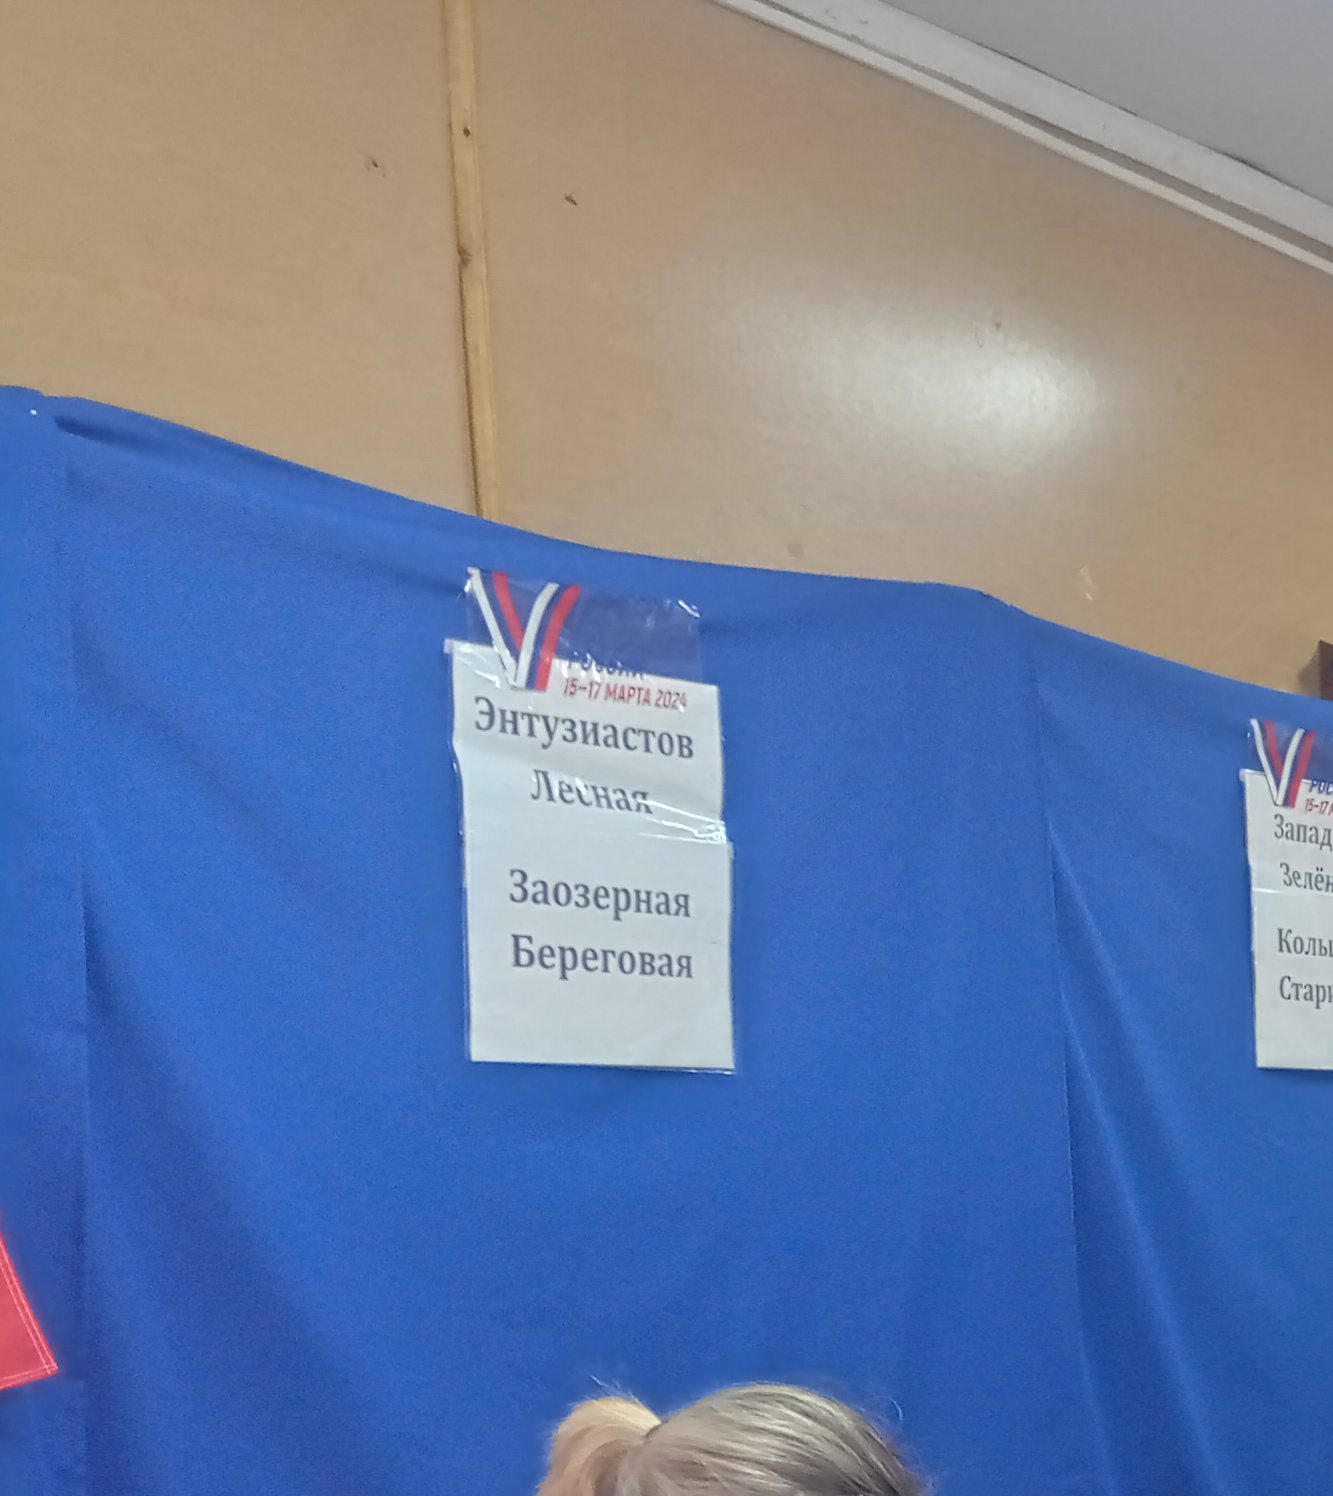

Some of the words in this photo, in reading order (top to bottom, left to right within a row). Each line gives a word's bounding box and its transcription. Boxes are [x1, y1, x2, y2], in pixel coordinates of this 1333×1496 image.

[604, 682, 651, 707] МАРТА
[474, 696, 694, 759] Энтузиастов
[531, 769, 653, 814] Лесная
[509, 869, 691, 920] Заозерная
[511, 934, 693, 980] Береговая
